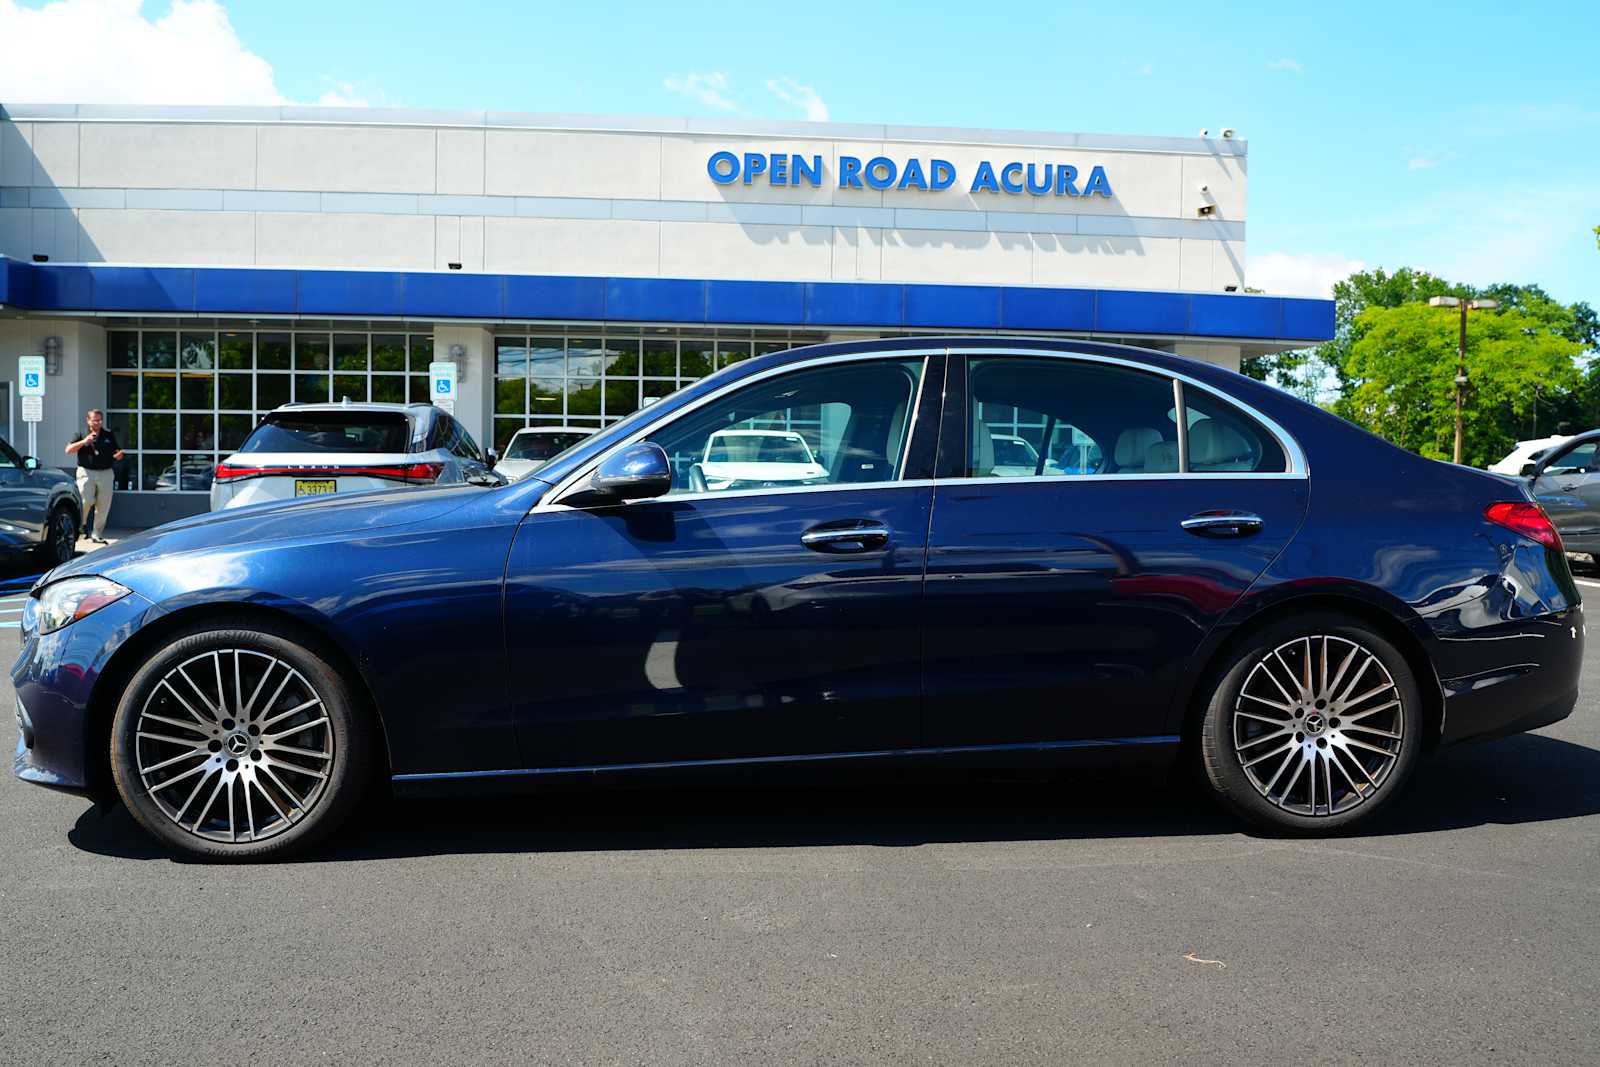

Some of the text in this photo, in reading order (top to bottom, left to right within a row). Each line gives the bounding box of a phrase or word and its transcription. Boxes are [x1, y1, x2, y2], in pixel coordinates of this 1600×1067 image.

[707, 151, 1114, 198] OPEN ROAD ACURA
